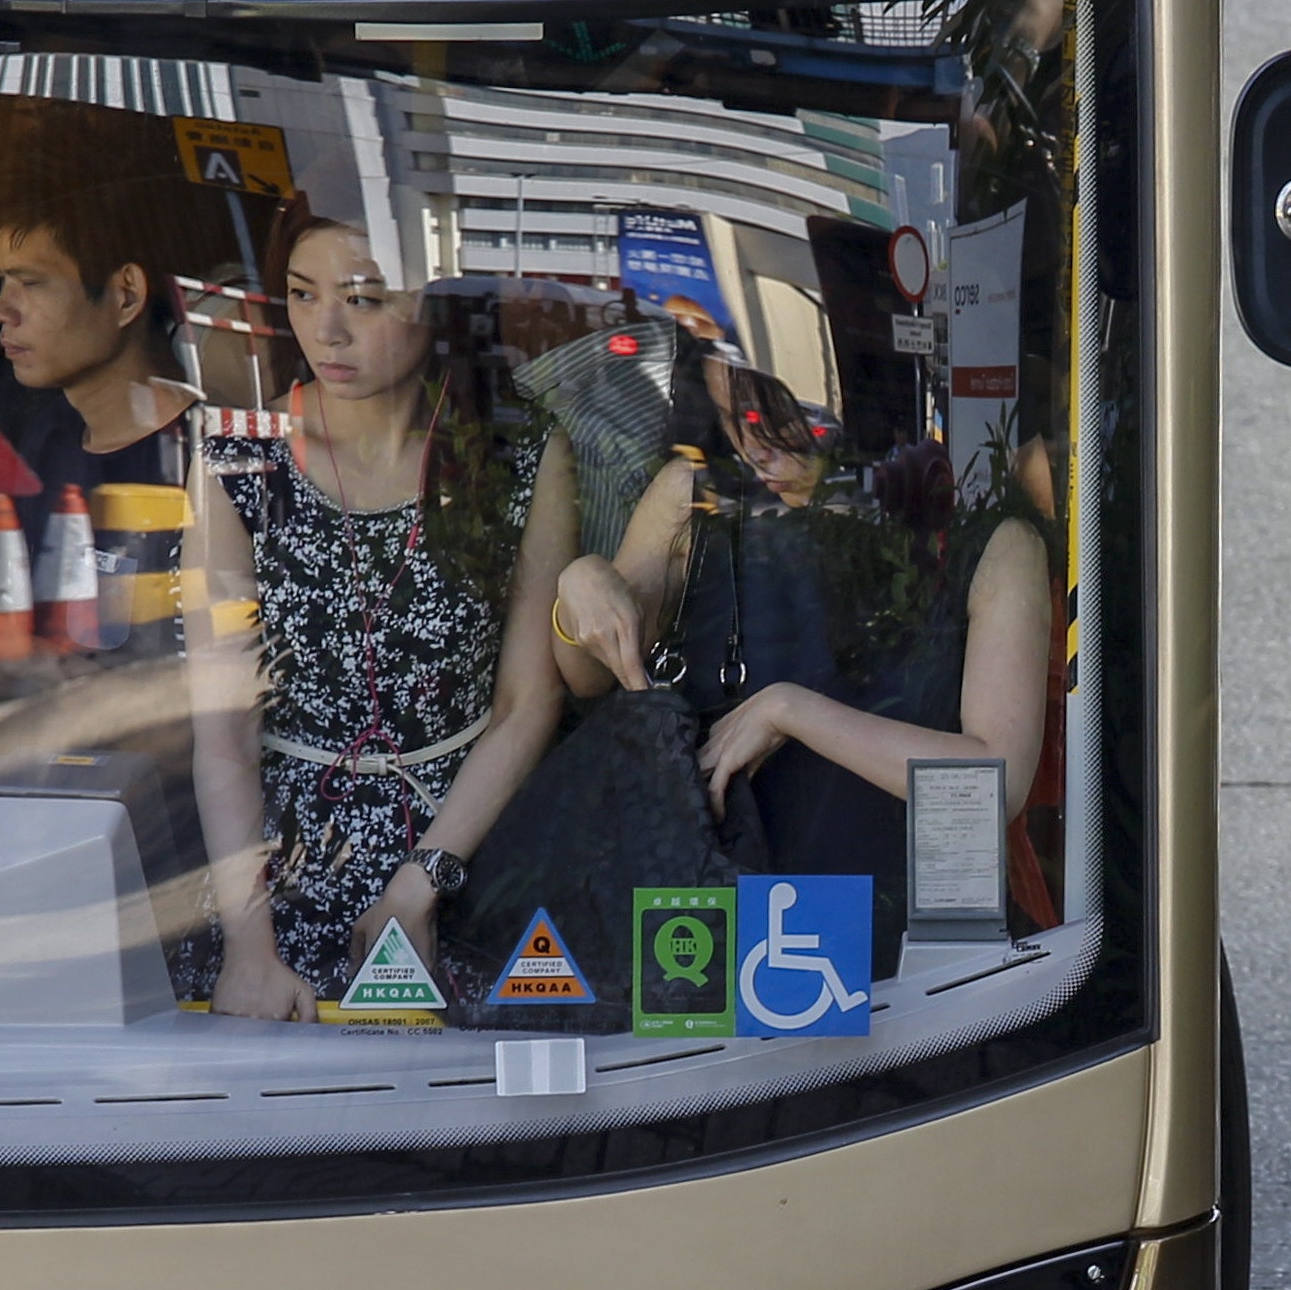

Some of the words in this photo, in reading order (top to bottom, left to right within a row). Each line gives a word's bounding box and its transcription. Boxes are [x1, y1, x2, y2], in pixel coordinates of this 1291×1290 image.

[533, 936, 551, 953] Q
[362, 987, 426, 999] HKQAA
[511, 983, 572, 993] HKQAA
[340, 1028, 385, 1036] Certificate
